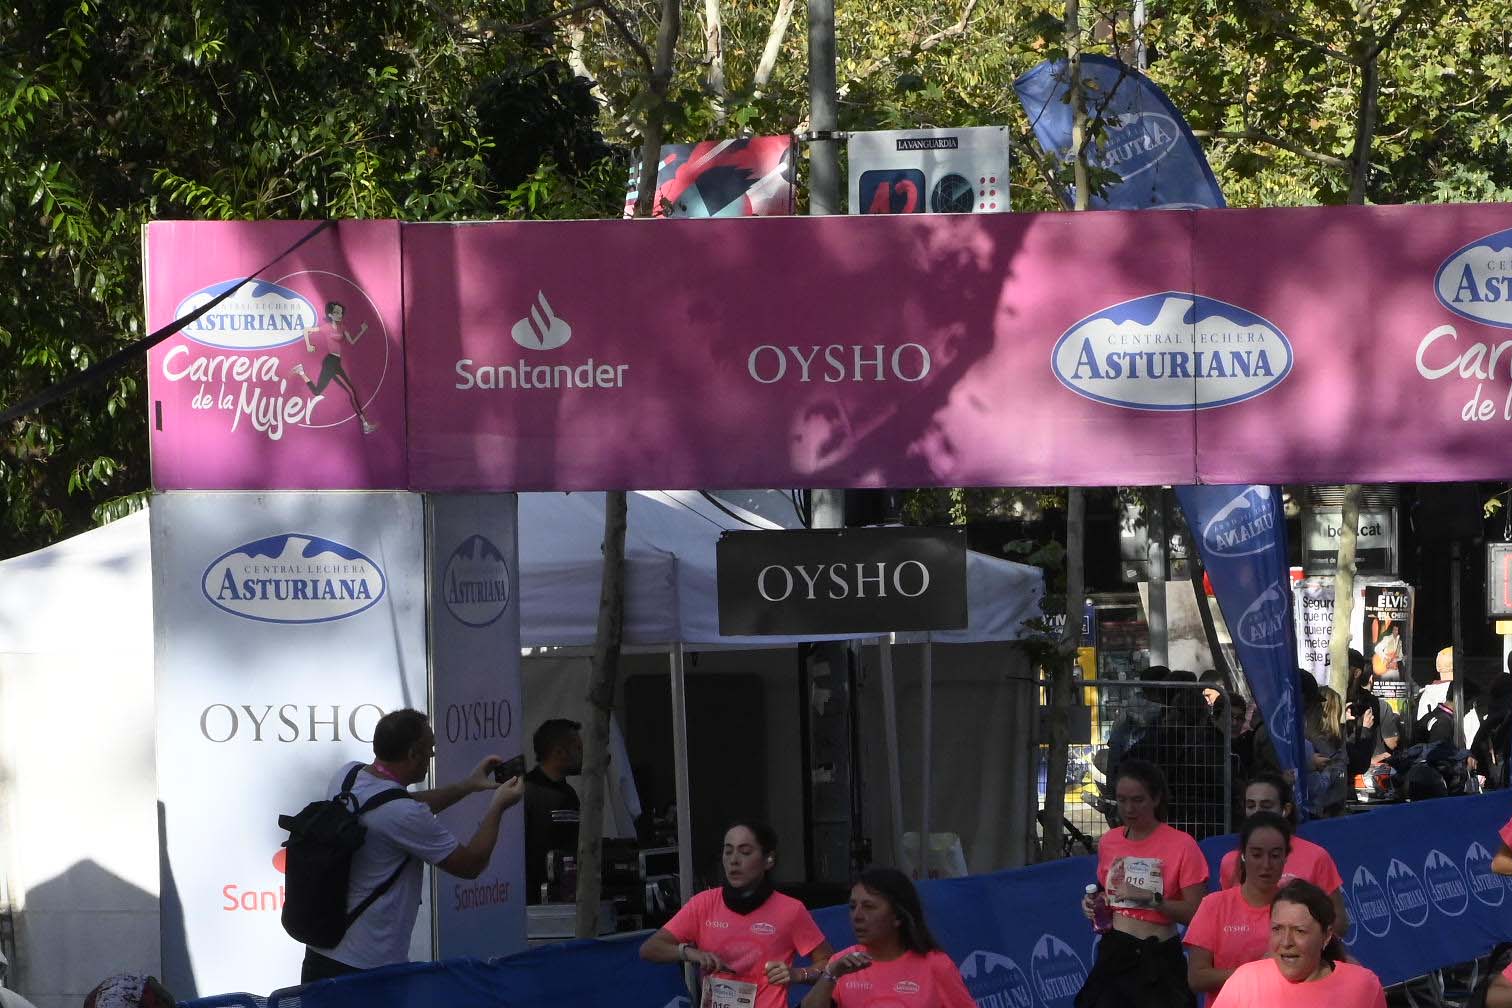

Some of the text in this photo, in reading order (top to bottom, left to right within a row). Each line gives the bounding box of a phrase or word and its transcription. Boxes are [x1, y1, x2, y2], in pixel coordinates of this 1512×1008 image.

[1108, 332, 1266, 346] CENTRAL LECHERA
[162, 344, 280, 382] Carrera
[455, 357, 629, 391] Santander
[747, 343, 931, 384] OYSHO
[1070, 337, 1275, 380] ASTURIANA
[192, 379, 325, 440] de la Mujer
[1461, 383, 1496, 422] de
[216, 568, 373, 601] ASTURIANA
[244, 564, 367, 575] CENTRAL LECHERA
[757, 560, 930, 602] OYSHO
[448, 574, 506, 604] ASTURIANA
[1377, 595, 1408, 609] ELVIS
[1303, 612, 1319, 624] que
[1304, 651, 1323, 662] este
[200, 703, 385, 743] OYSHO
[445, 700, 512, 743] OYSHO
[454, 882, 509, 912] Santander
